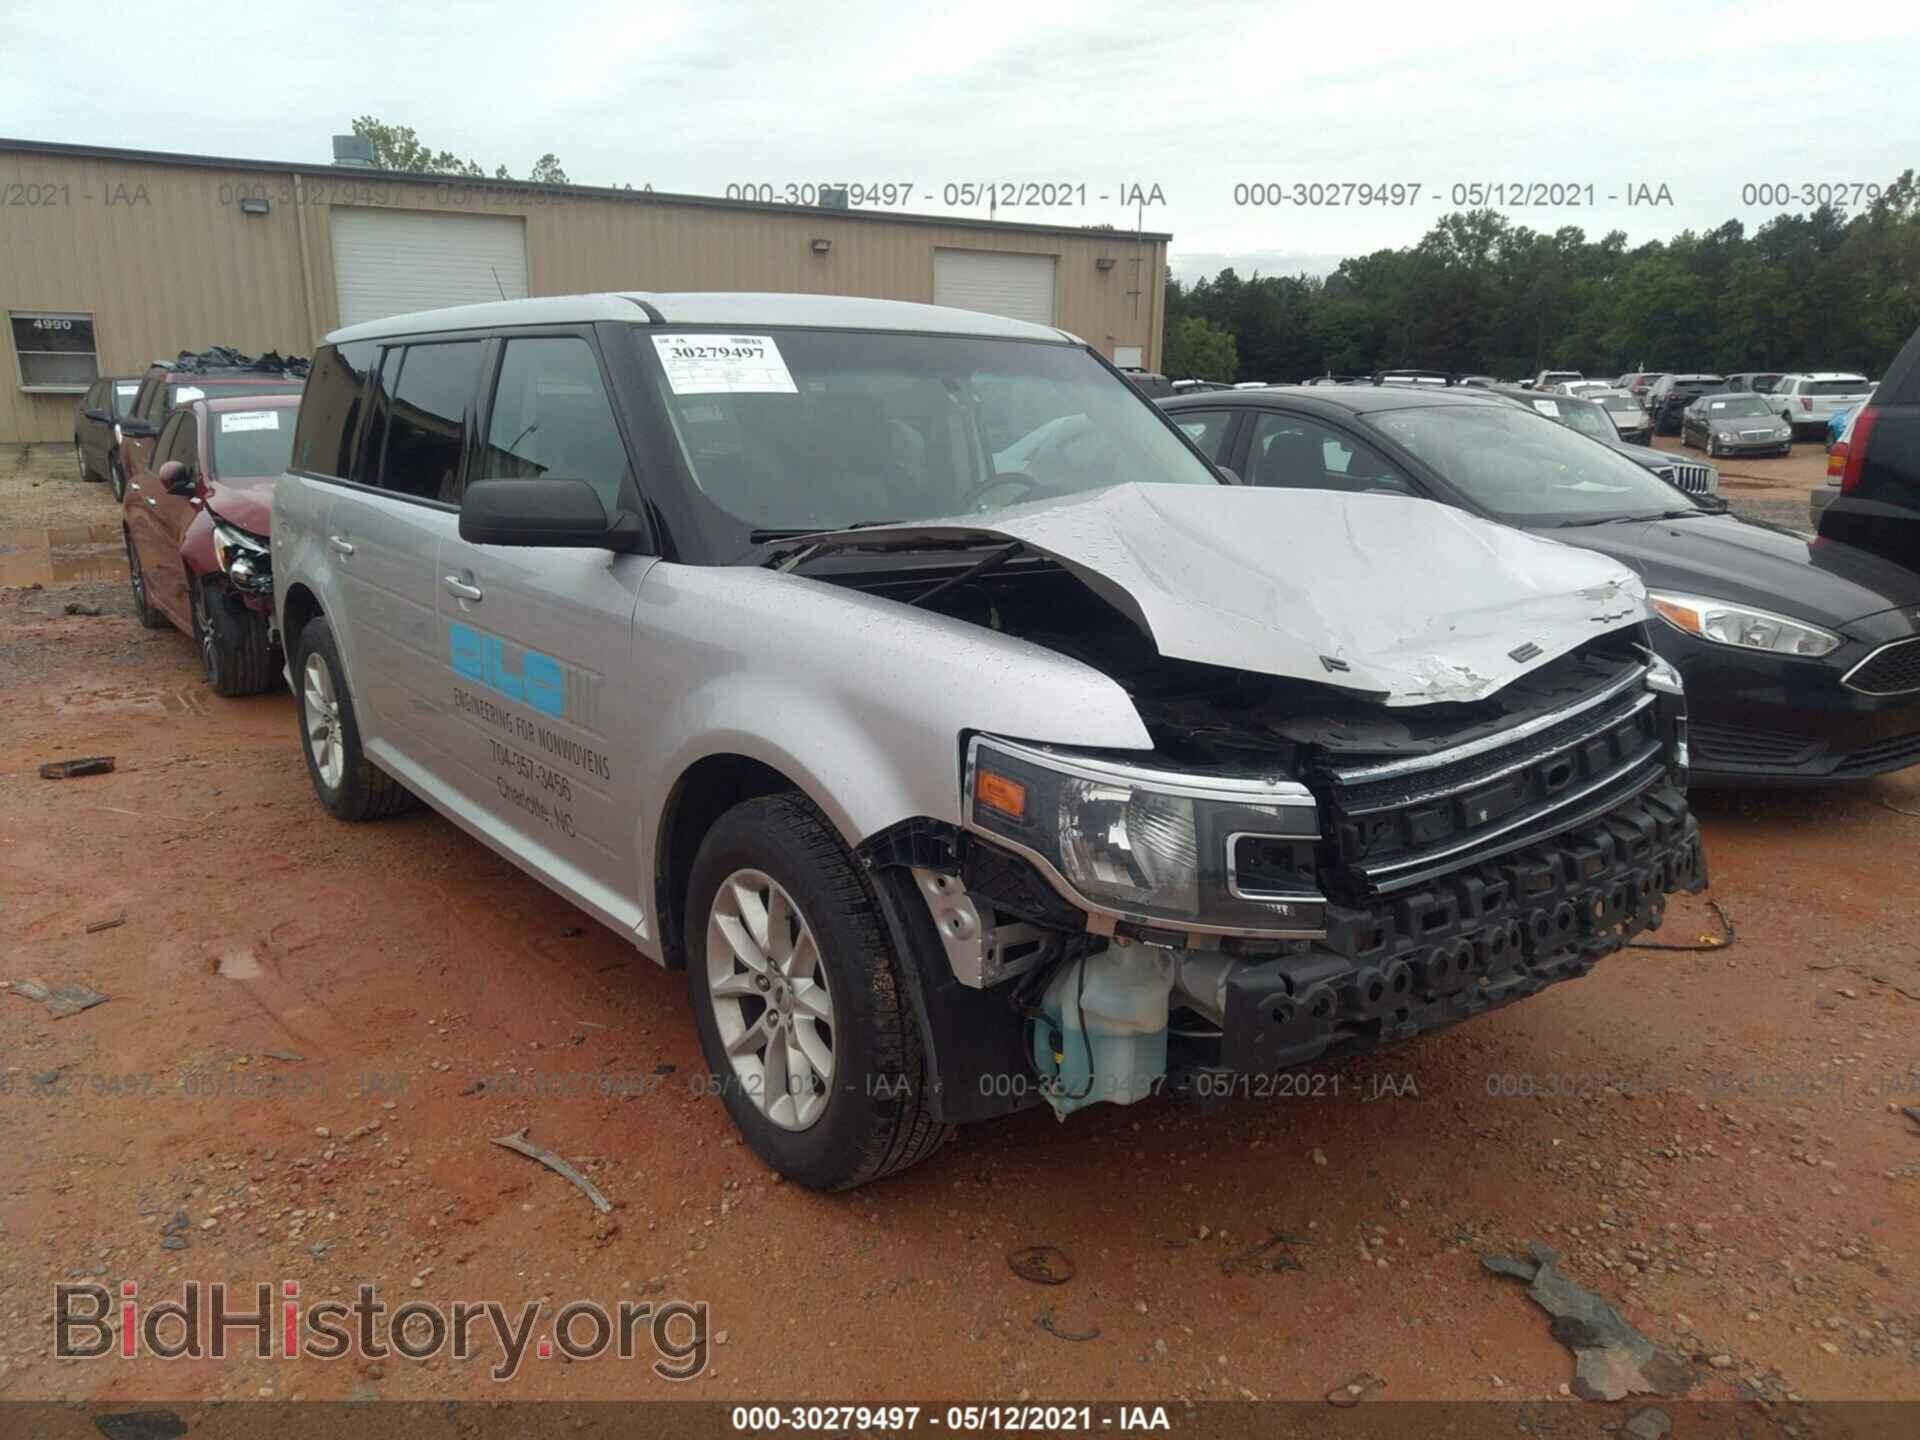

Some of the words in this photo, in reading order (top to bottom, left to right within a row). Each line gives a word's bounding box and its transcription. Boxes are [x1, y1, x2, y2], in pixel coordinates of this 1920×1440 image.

[33, 319, 72, 330] 4990
[670, 347, 764, 359] 30279497
[453, 687, 513, 734] ENGINEERING
[516, 716, 535, 743] FOR
[538, 727, 611, 780] NONWOVENS
[489, 739, 571, 801] 704-357-3456
[553, 805, 577, 838] NC
